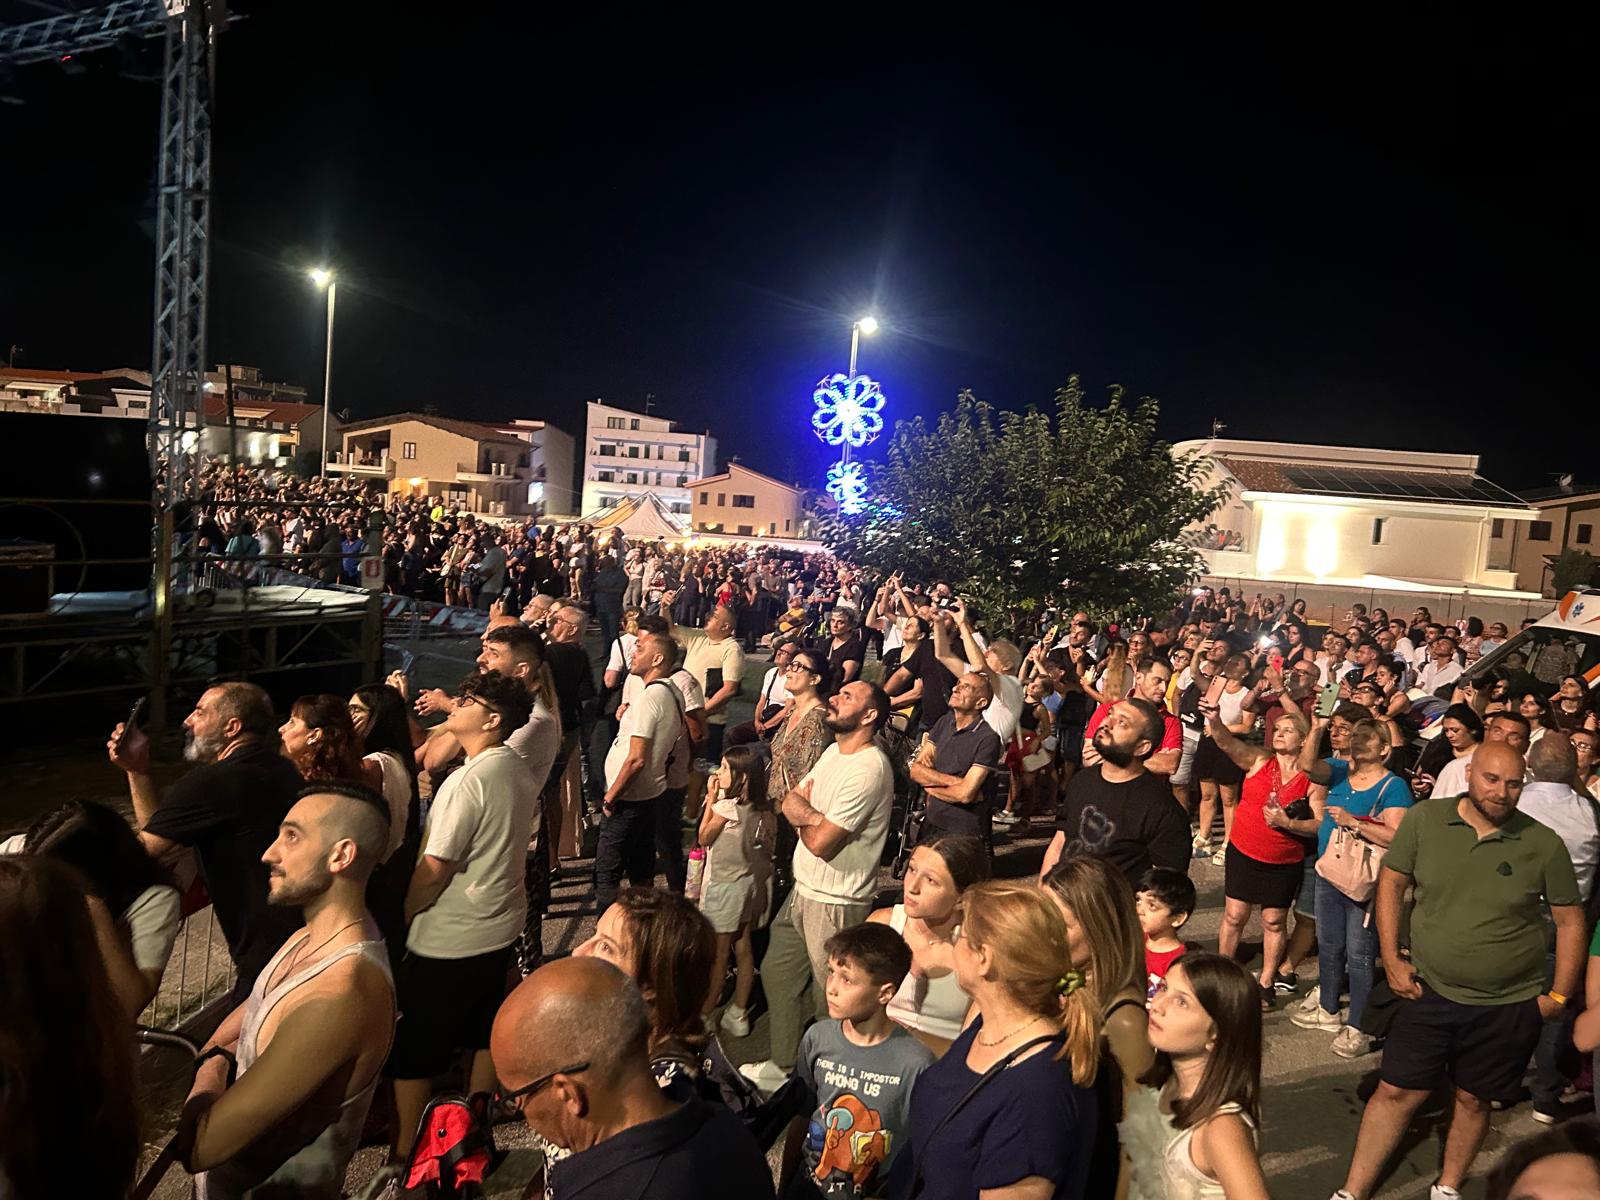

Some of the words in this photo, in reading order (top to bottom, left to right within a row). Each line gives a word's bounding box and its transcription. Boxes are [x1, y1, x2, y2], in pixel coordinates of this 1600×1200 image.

[816, 1058, 835, 1070] THERE
[838, 1064, 847, 1074] IS
[850, 1068, 855, 1076] 1
[860, 1070, 900, 1085] IMPOSTOR
[824, 1071, 859, 1091] AMONG
[863, 1082, 881, 1097] US
